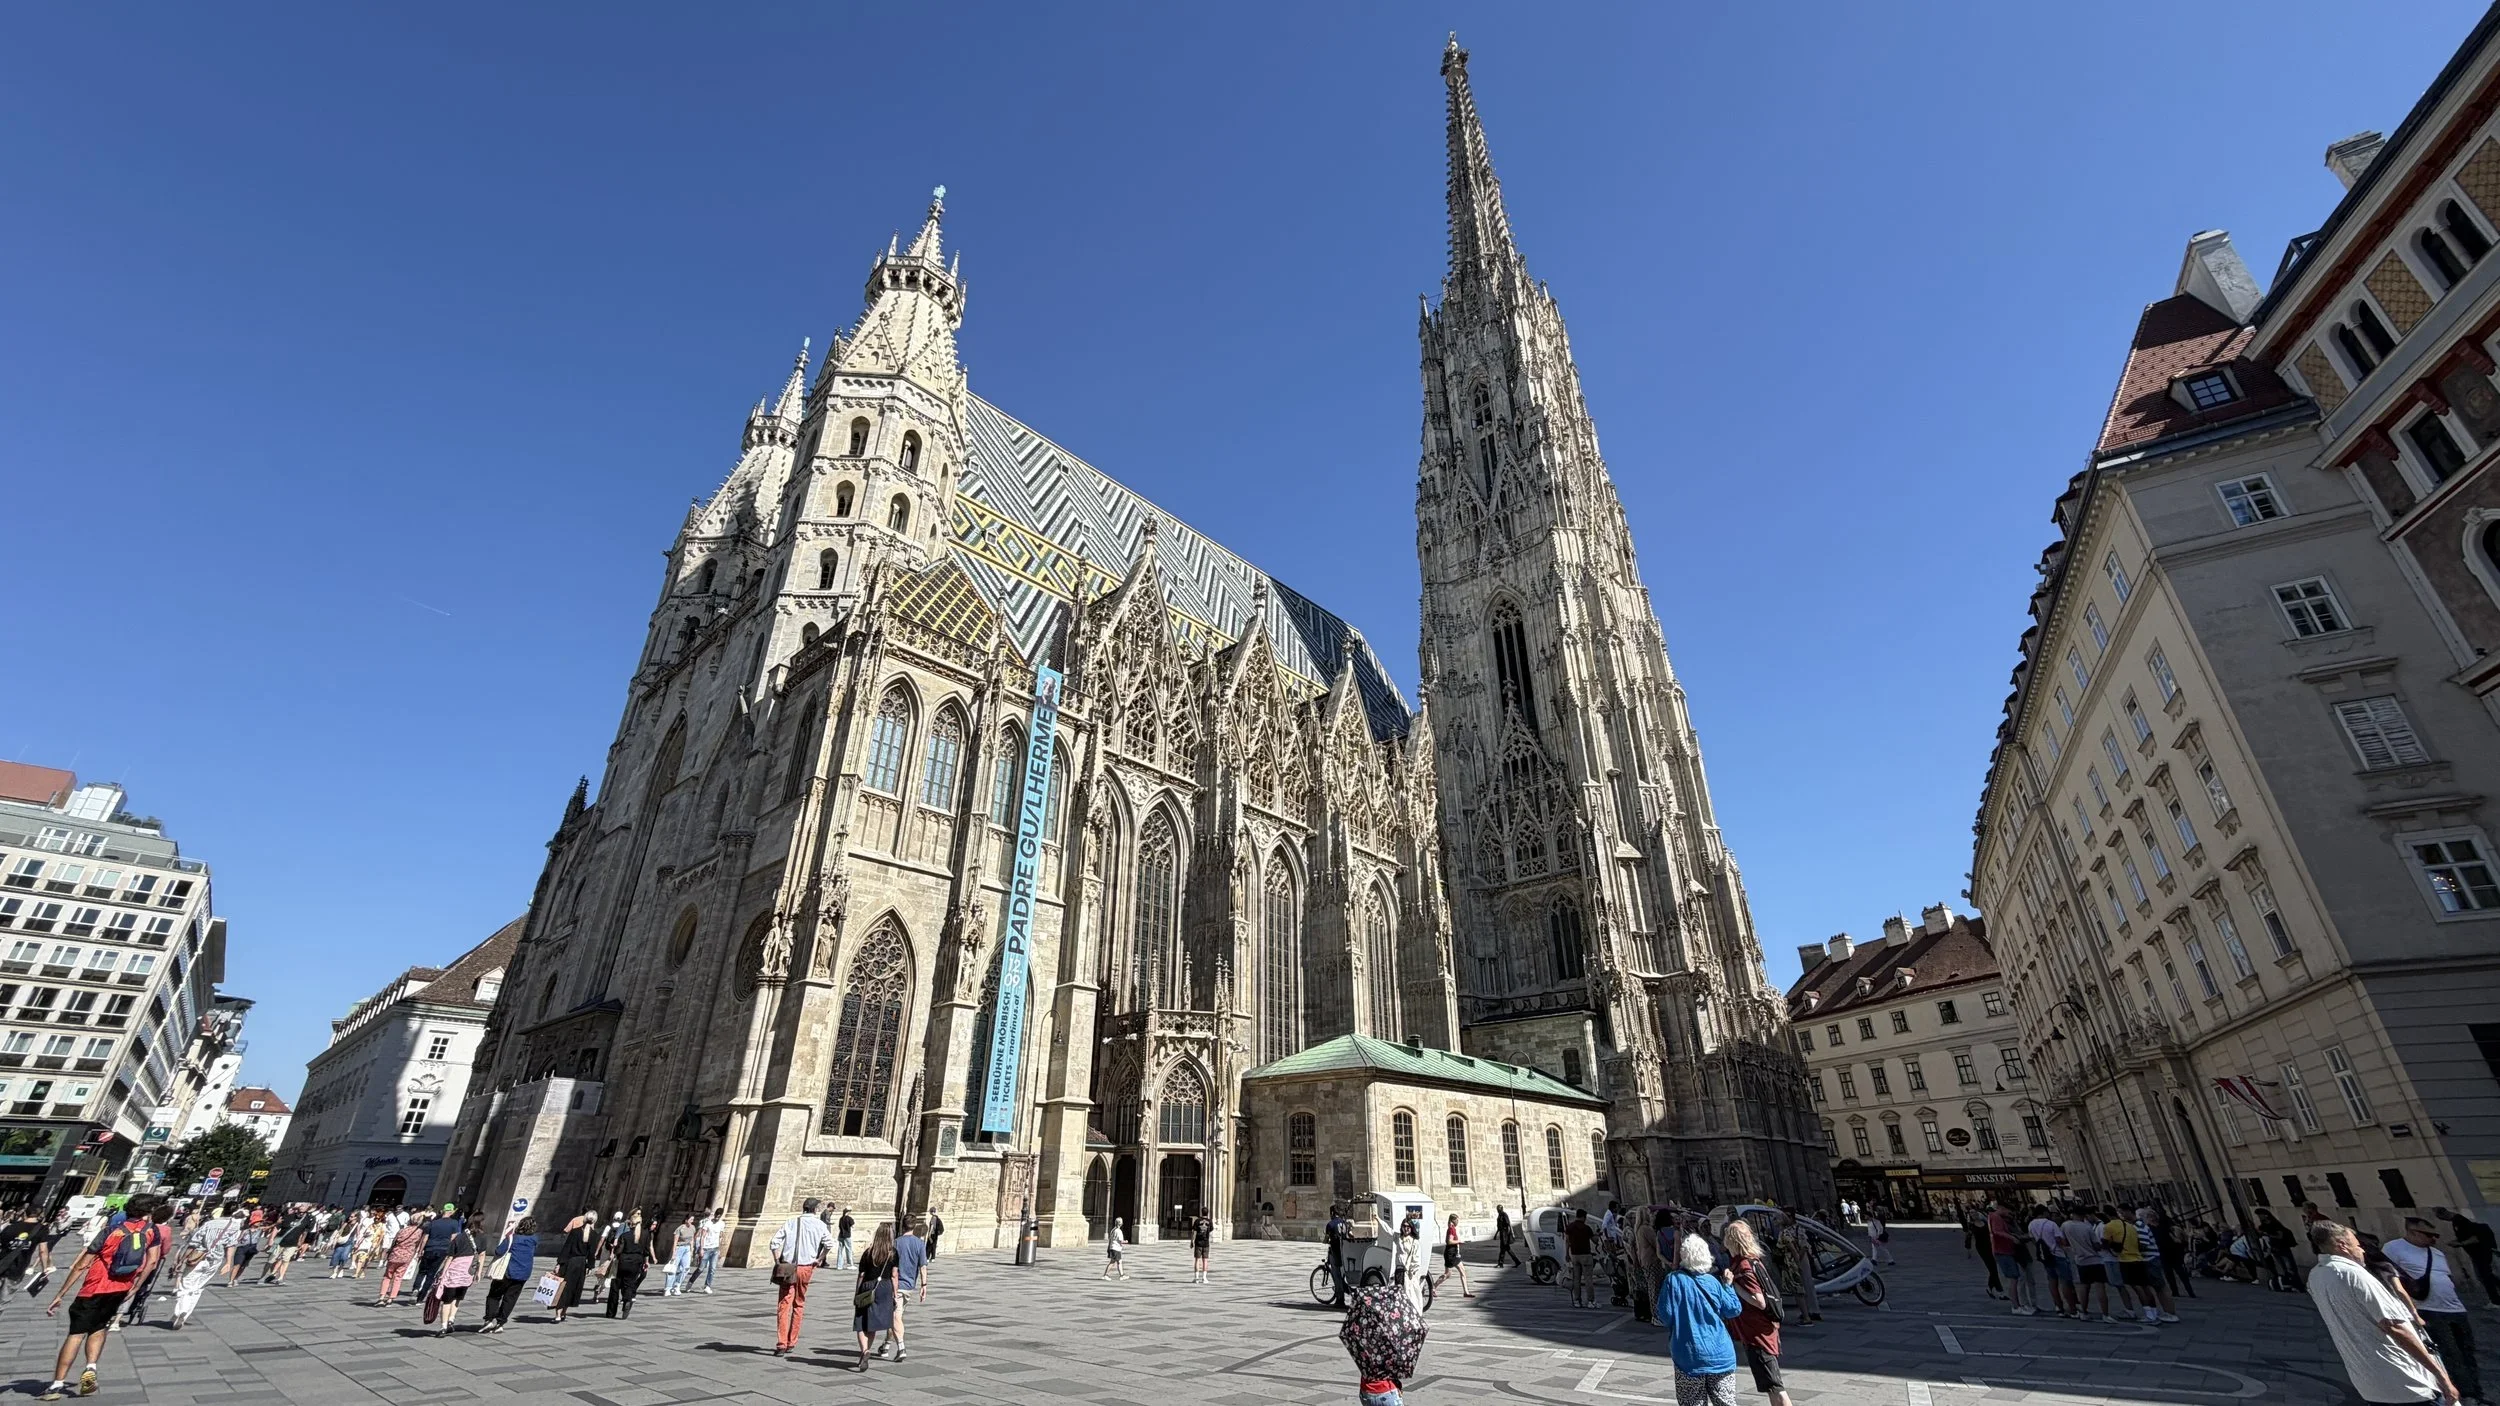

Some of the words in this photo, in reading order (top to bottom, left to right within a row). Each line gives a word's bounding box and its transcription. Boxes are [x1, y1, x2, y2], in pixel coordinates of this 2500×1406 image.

[1008, 861, 1034, 956] PADRE
[991, 1048, 1005, 1103] SEEBÜHNE
[999, 991, 1011, 1047] MÖRBISCH
[1002, 1065, 1013, 1103] TICKETS
[1966, 1174, 2015, 1183] DENKSTEIN
[537, 1286, 553, 1296] BOSS
